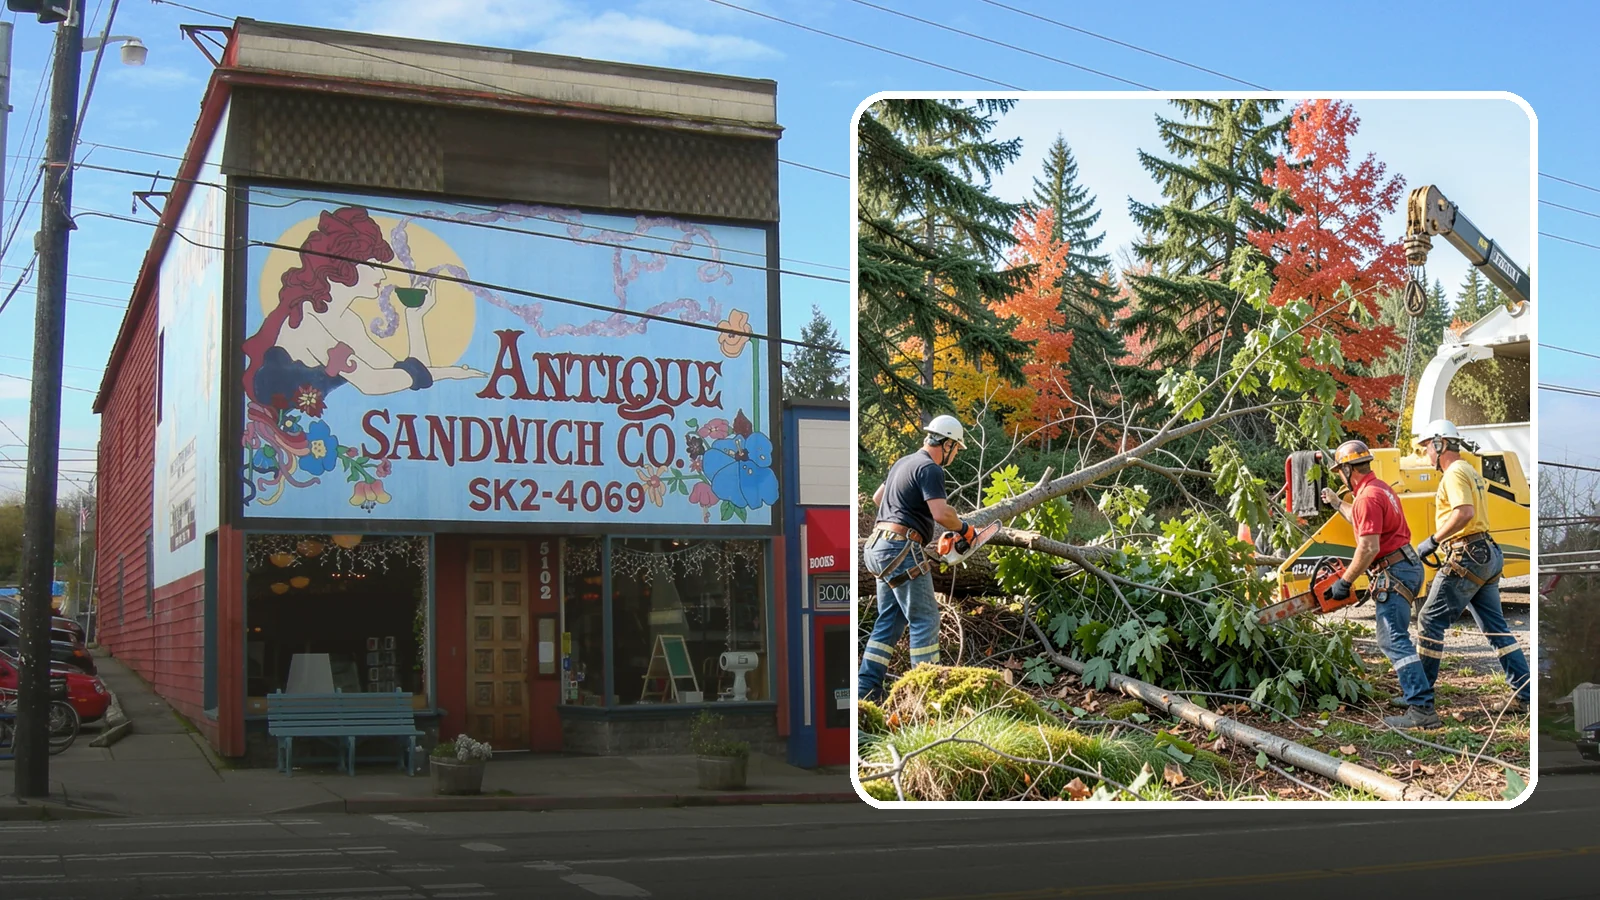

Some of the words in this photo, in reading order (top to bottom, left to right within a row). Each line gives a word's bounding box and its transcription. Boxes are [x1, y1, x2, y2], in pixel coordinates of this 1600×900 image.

[476, 329, 723, 420] ANTIQUE
[361, 408, 604, 468] SANDWICH
[617, 422, 685, 469] CO.
[468, 476, 646, 512] SK2-4069
[540, 542, 552, 599] 5102
[809, 555, 835, 568] BOOKS
